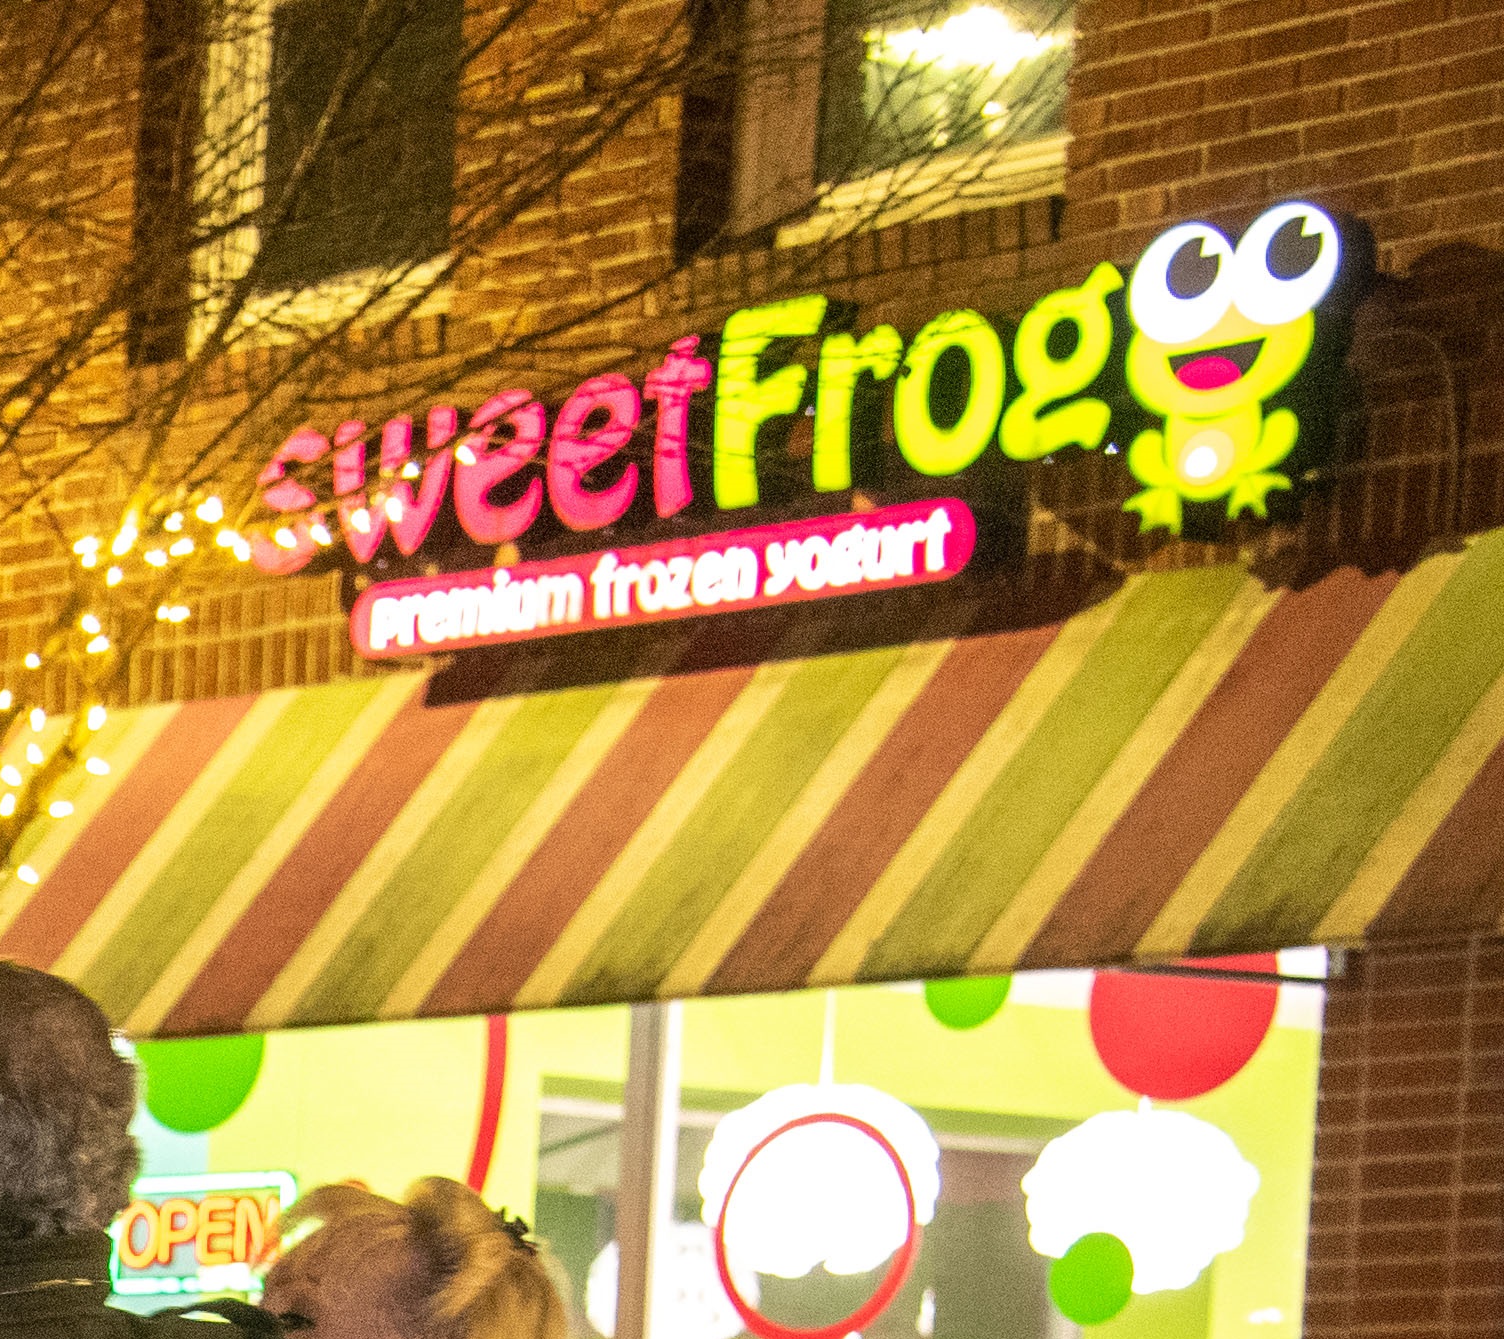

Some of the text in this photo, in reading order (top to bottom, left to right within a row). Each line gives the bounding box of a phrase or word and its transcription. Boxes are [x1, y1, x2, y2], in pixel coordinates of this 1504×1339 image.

[368, 506, 952, 651] premium frozen yogurt
[118, 1196, 283, 1268] OPEN
